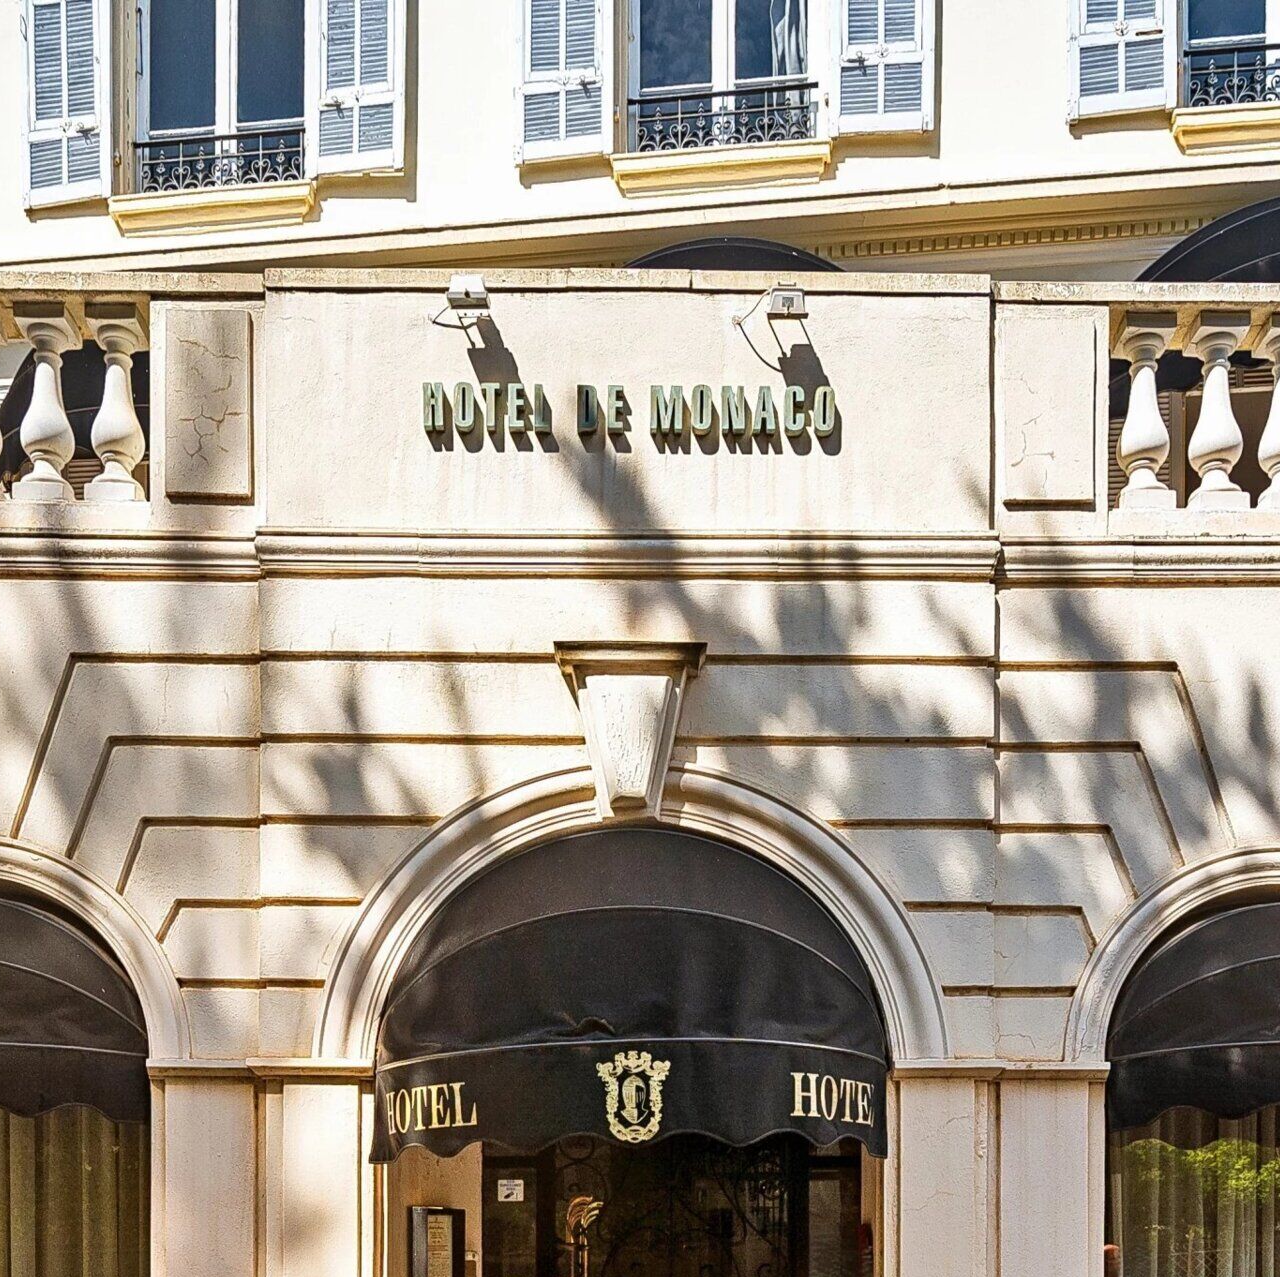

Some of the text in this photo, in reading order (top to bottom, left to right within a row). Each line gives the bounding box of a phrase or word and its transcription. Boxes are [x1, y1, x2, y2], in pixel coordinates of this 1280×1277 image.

[422, 382, 836, 437] HOTEL DE MONACO
[385, 1082, 478, 1135] HOTEL
[790, 1071, 875, 1128] HOTE
